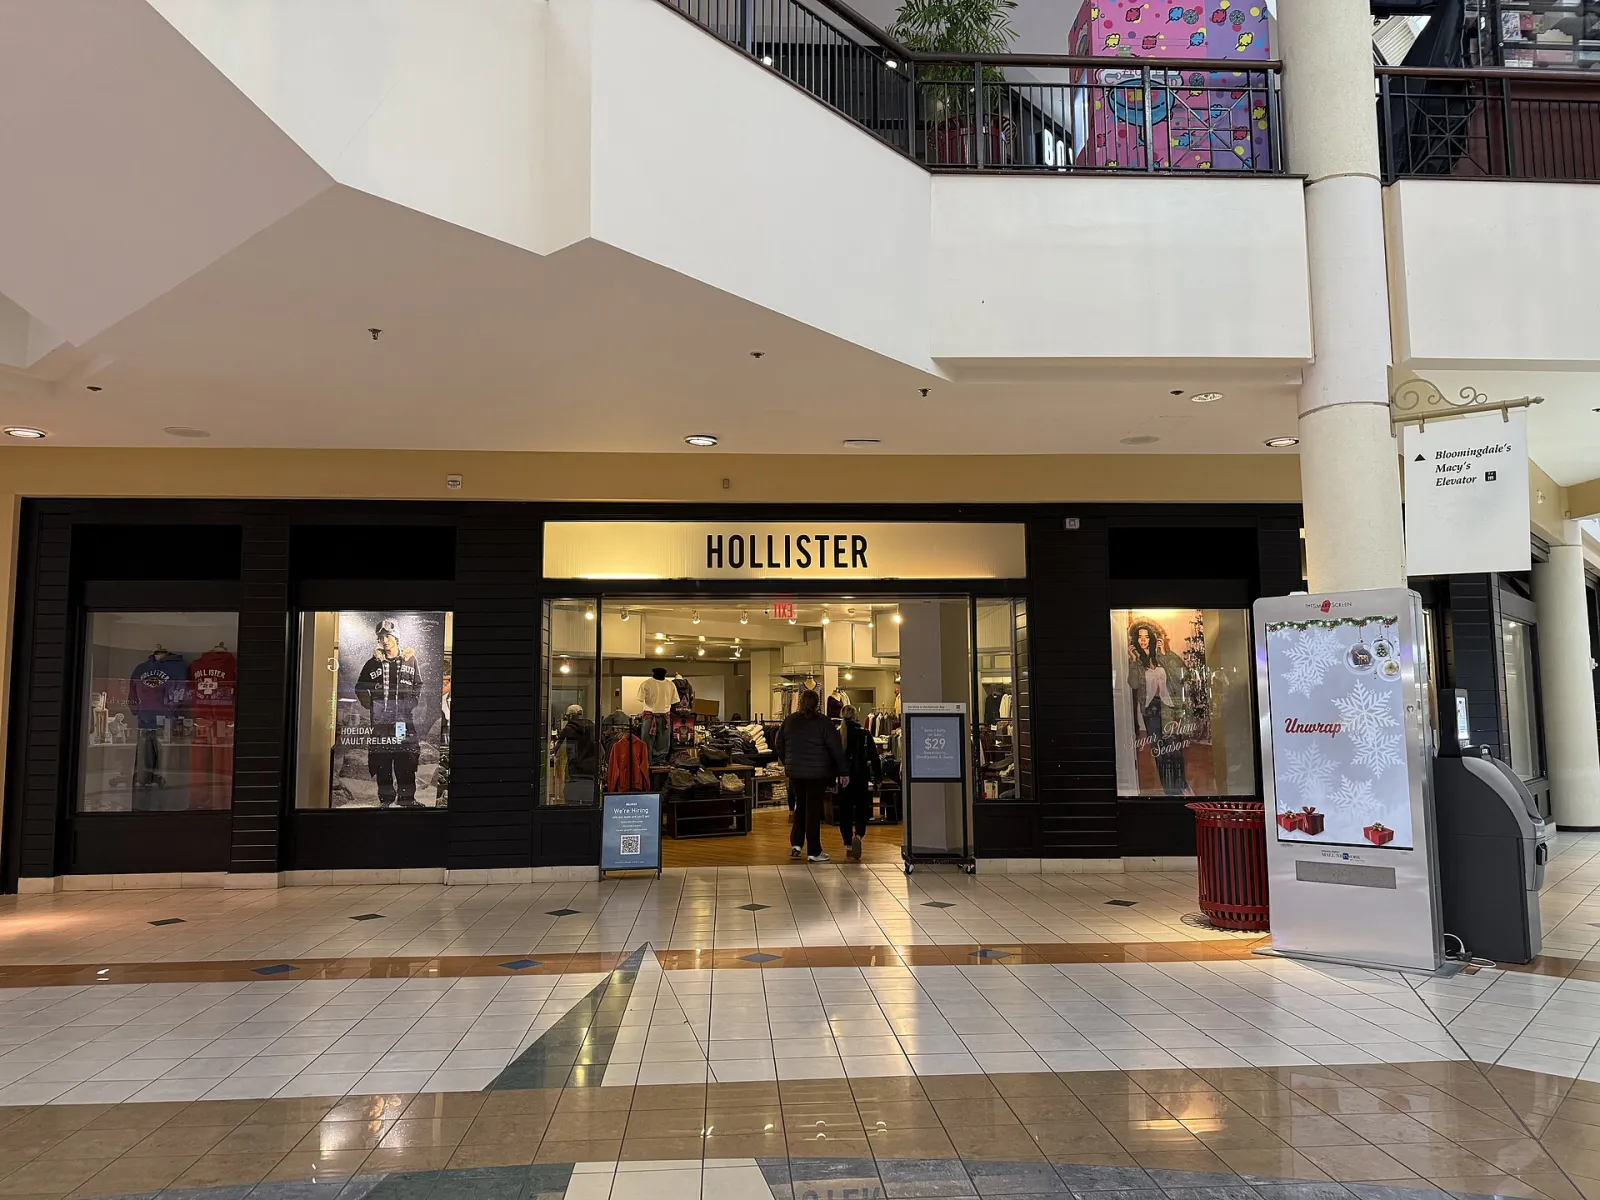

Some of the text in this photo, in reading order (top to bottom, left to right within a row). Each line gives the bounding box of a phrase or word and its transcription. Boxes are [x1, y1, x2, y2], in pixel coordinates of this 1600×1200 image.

[1435, 443, 1512, 460] Bloomingdale's
[1435, 461, 1471, 474] Macy's
[1435, 475, 1477, 487] Elevator
[707, 534, 868, 569] HOLLISTER
[140, 670, 170, 682] HOLLISTER
[194, 669, 226, 680] HOLLISTER
[1162, 719, 1198, 739] Plum
[1284, 718, 1341, 738] Unwrap
[341, 737, 364, 745] VAULT
[924, 738, 946, 750] $29
[1151, 739, 1191, 757] Season
